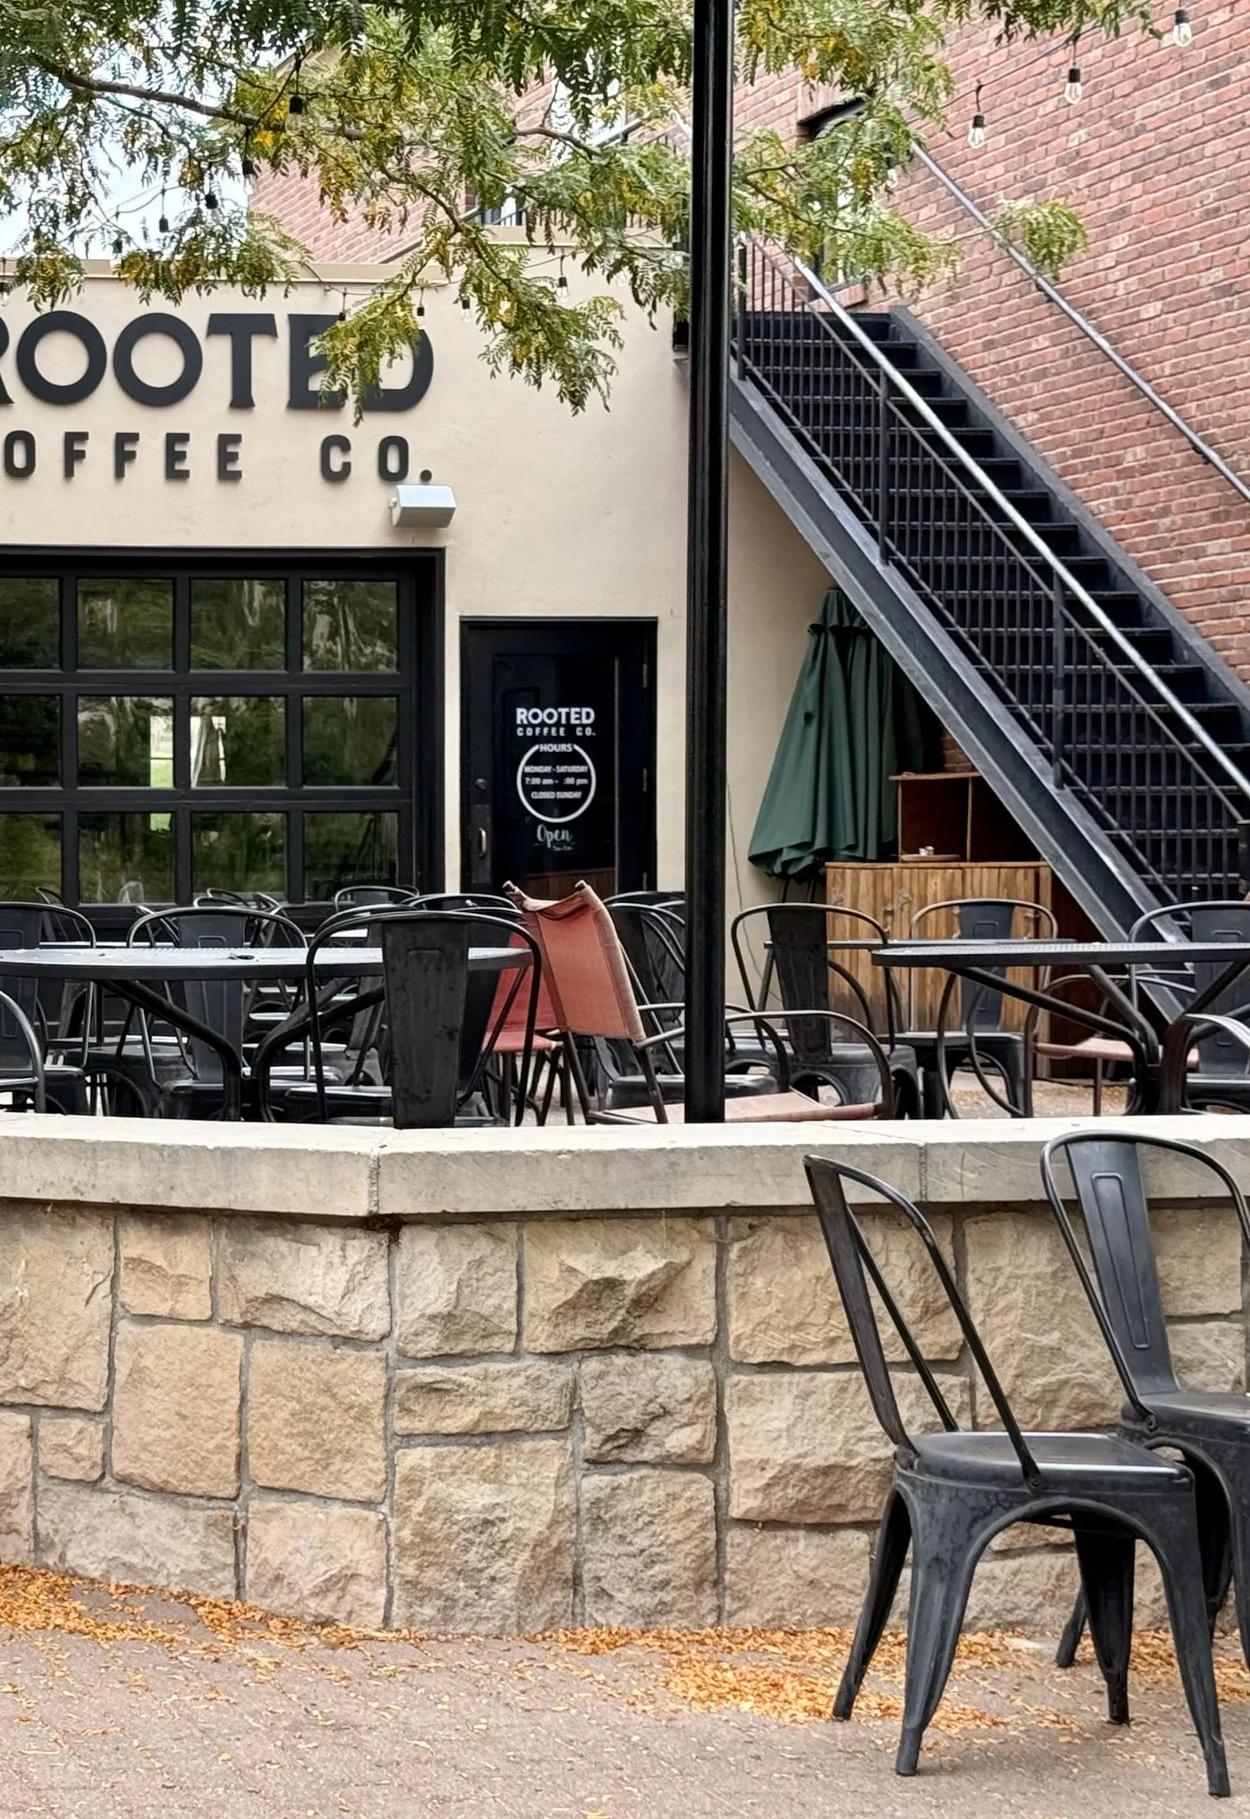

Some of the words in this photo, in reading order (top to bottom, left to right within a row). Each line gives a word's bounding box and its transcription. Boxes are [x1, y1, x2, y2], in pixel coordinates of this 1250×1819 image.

[320, 434, 433, 483] CO.
[515, 707, 596, 725] ROOTED
[516, 726, 567, 737] COFFEE
[575, 726, 597, 737] CO.
[539, 743, 573, 753] HOURS
[524, 765, 552, 773] MONDAY
[556, 765, 588, 773] SATURDAY
[531, 791, 556, 799] CLOSED
[556, 791, 582, 799] SUNDAY
[537, 823, 573, 849] Open
